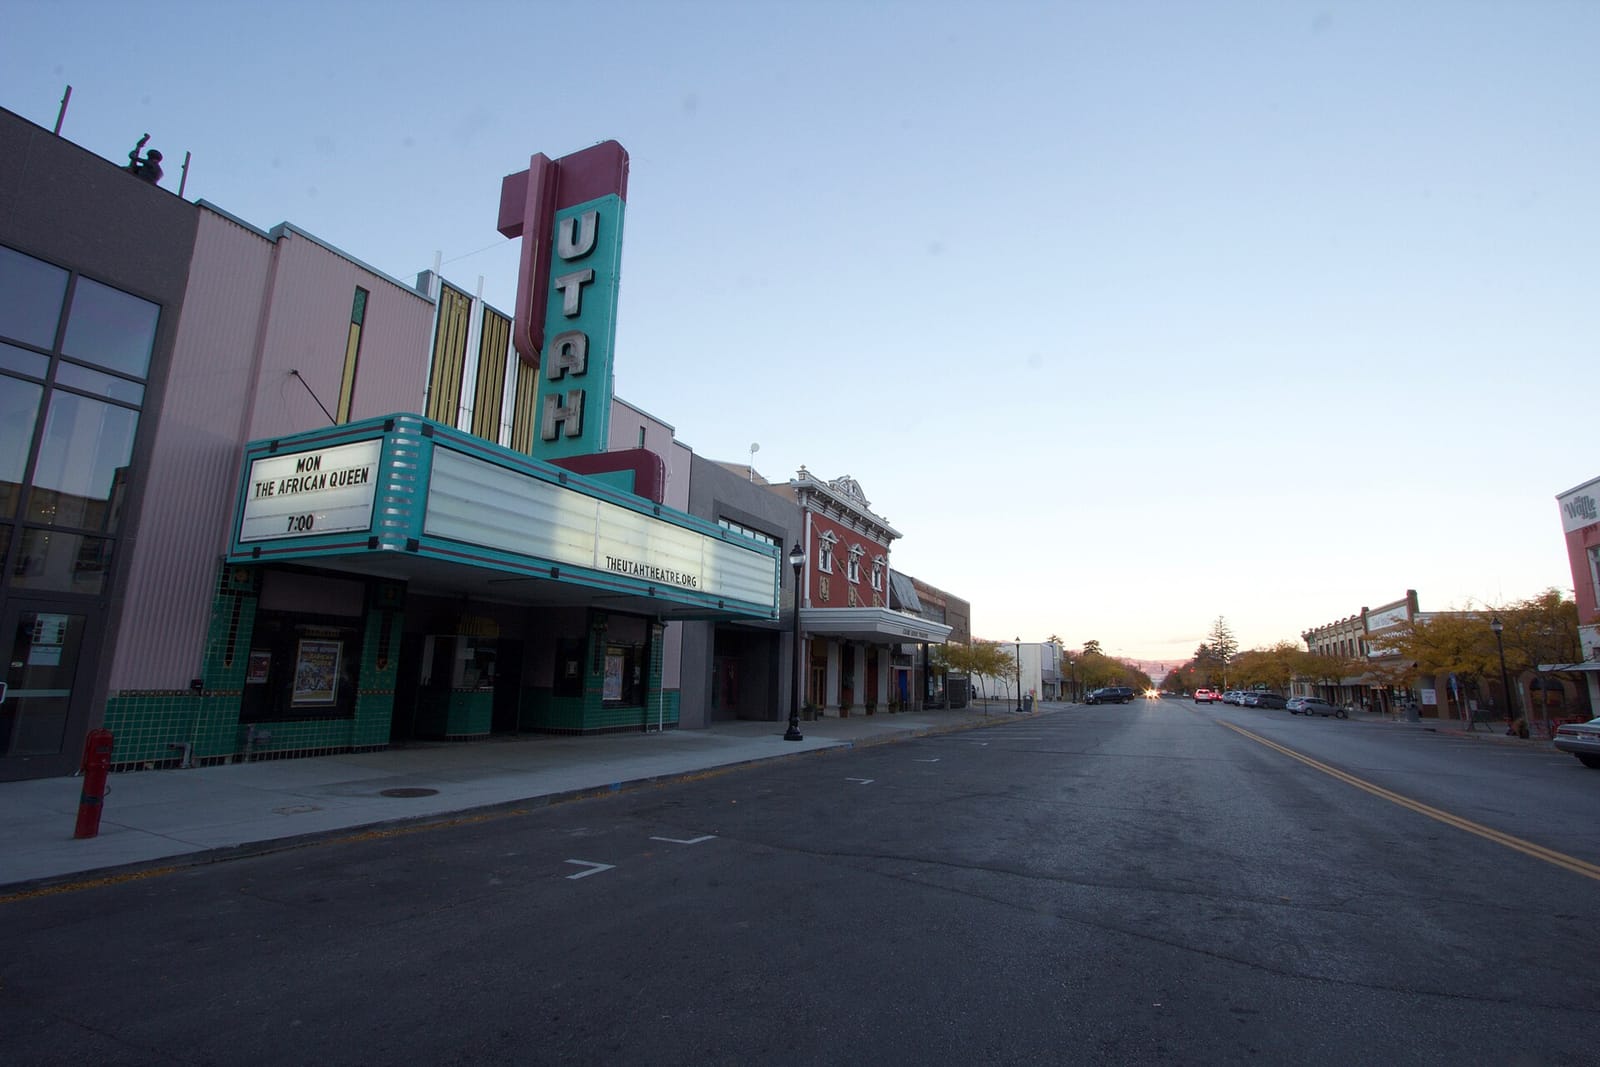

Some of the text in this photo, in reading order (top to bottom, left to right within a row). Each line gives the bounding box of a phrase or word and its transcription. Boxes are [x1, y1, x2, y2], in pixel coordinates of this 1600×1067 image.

[541, 208, 600, 443] UTAH
[296, 455, 321, 474] MON
[256, 467, 369, 498] THE AFRICAN QUEEN
[287, 514, 314, 532] 7:00
[606, 555, 697, 587] THEUTAHTHEATRE.ORG
